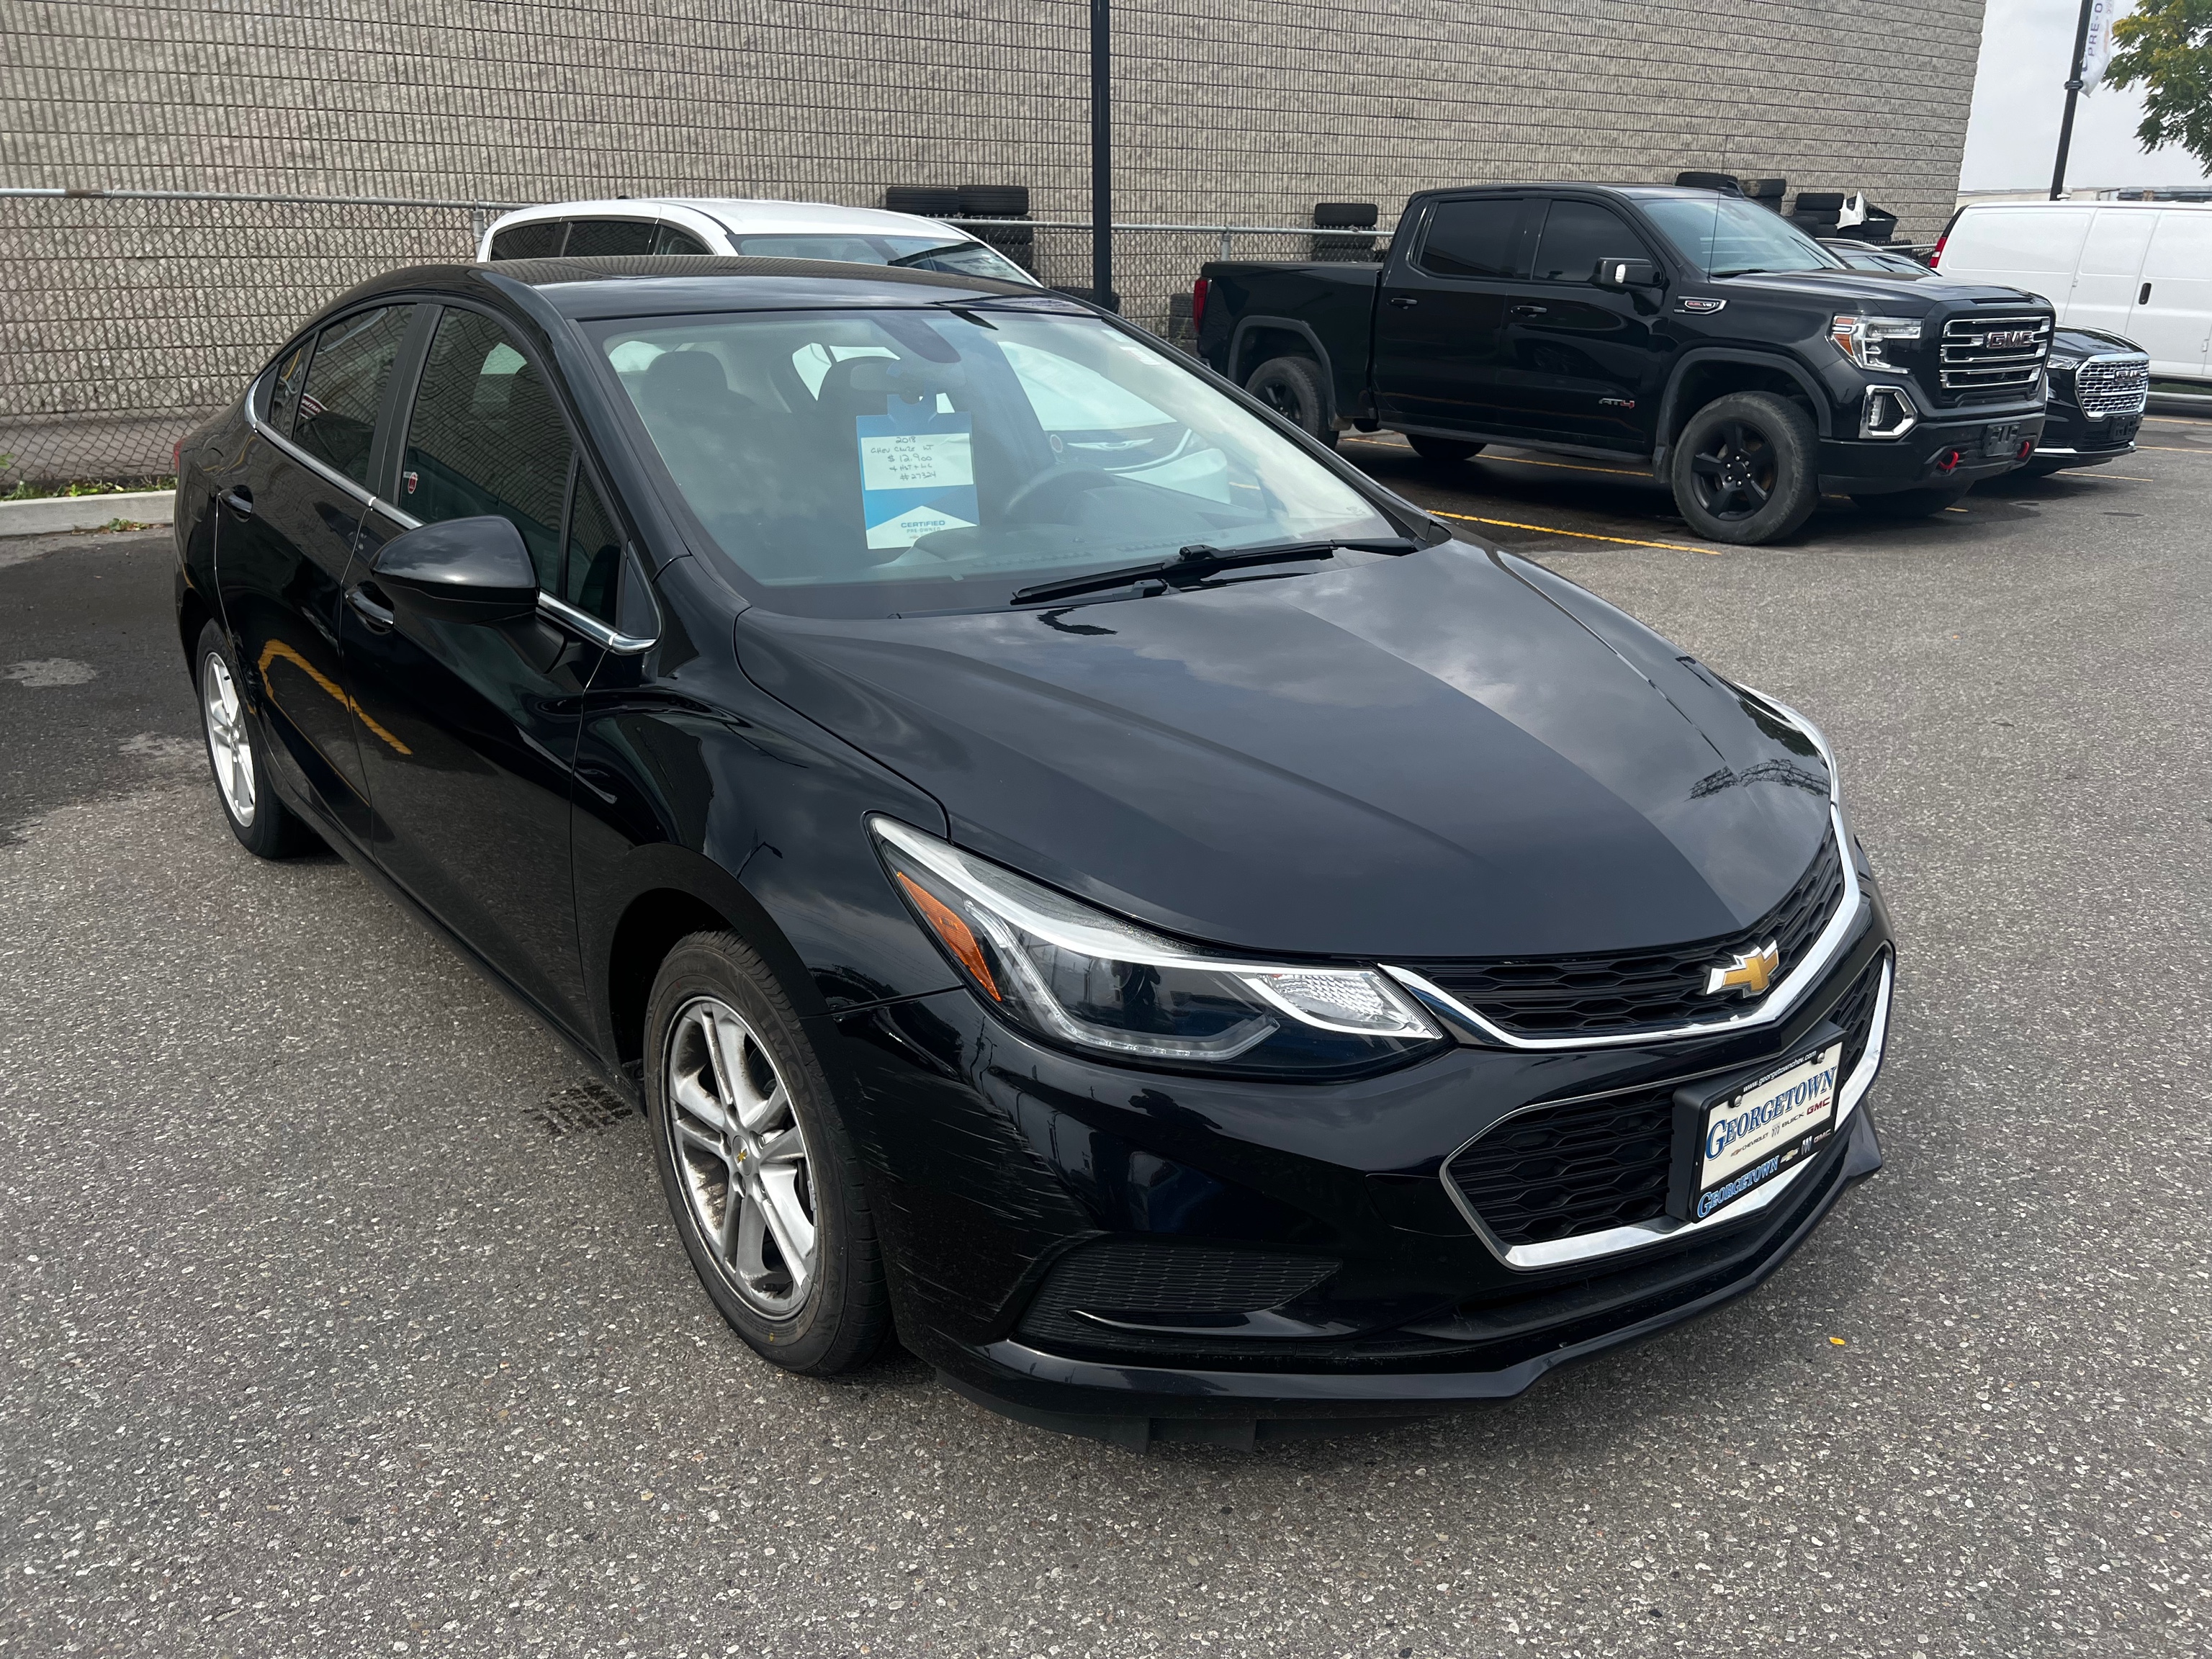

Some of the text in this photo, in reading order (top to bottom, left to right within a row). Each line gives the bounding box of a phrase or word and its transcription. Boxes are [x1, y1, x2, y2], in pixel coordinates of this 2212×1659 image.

[1987, 331, 2032, 349] GMC
[1599, 397, 1635, 409] AT4
[1743, 1051, 1817, 1092] www.georgetownchev.com
[1705, 1066, 1837, 1161] GEORGETOWN
[1742, 1097, 1830, 1151] CHEVROLET BUICK GMC
[1696, 1128, 1831, 1218] GEORGETOWN GMC
